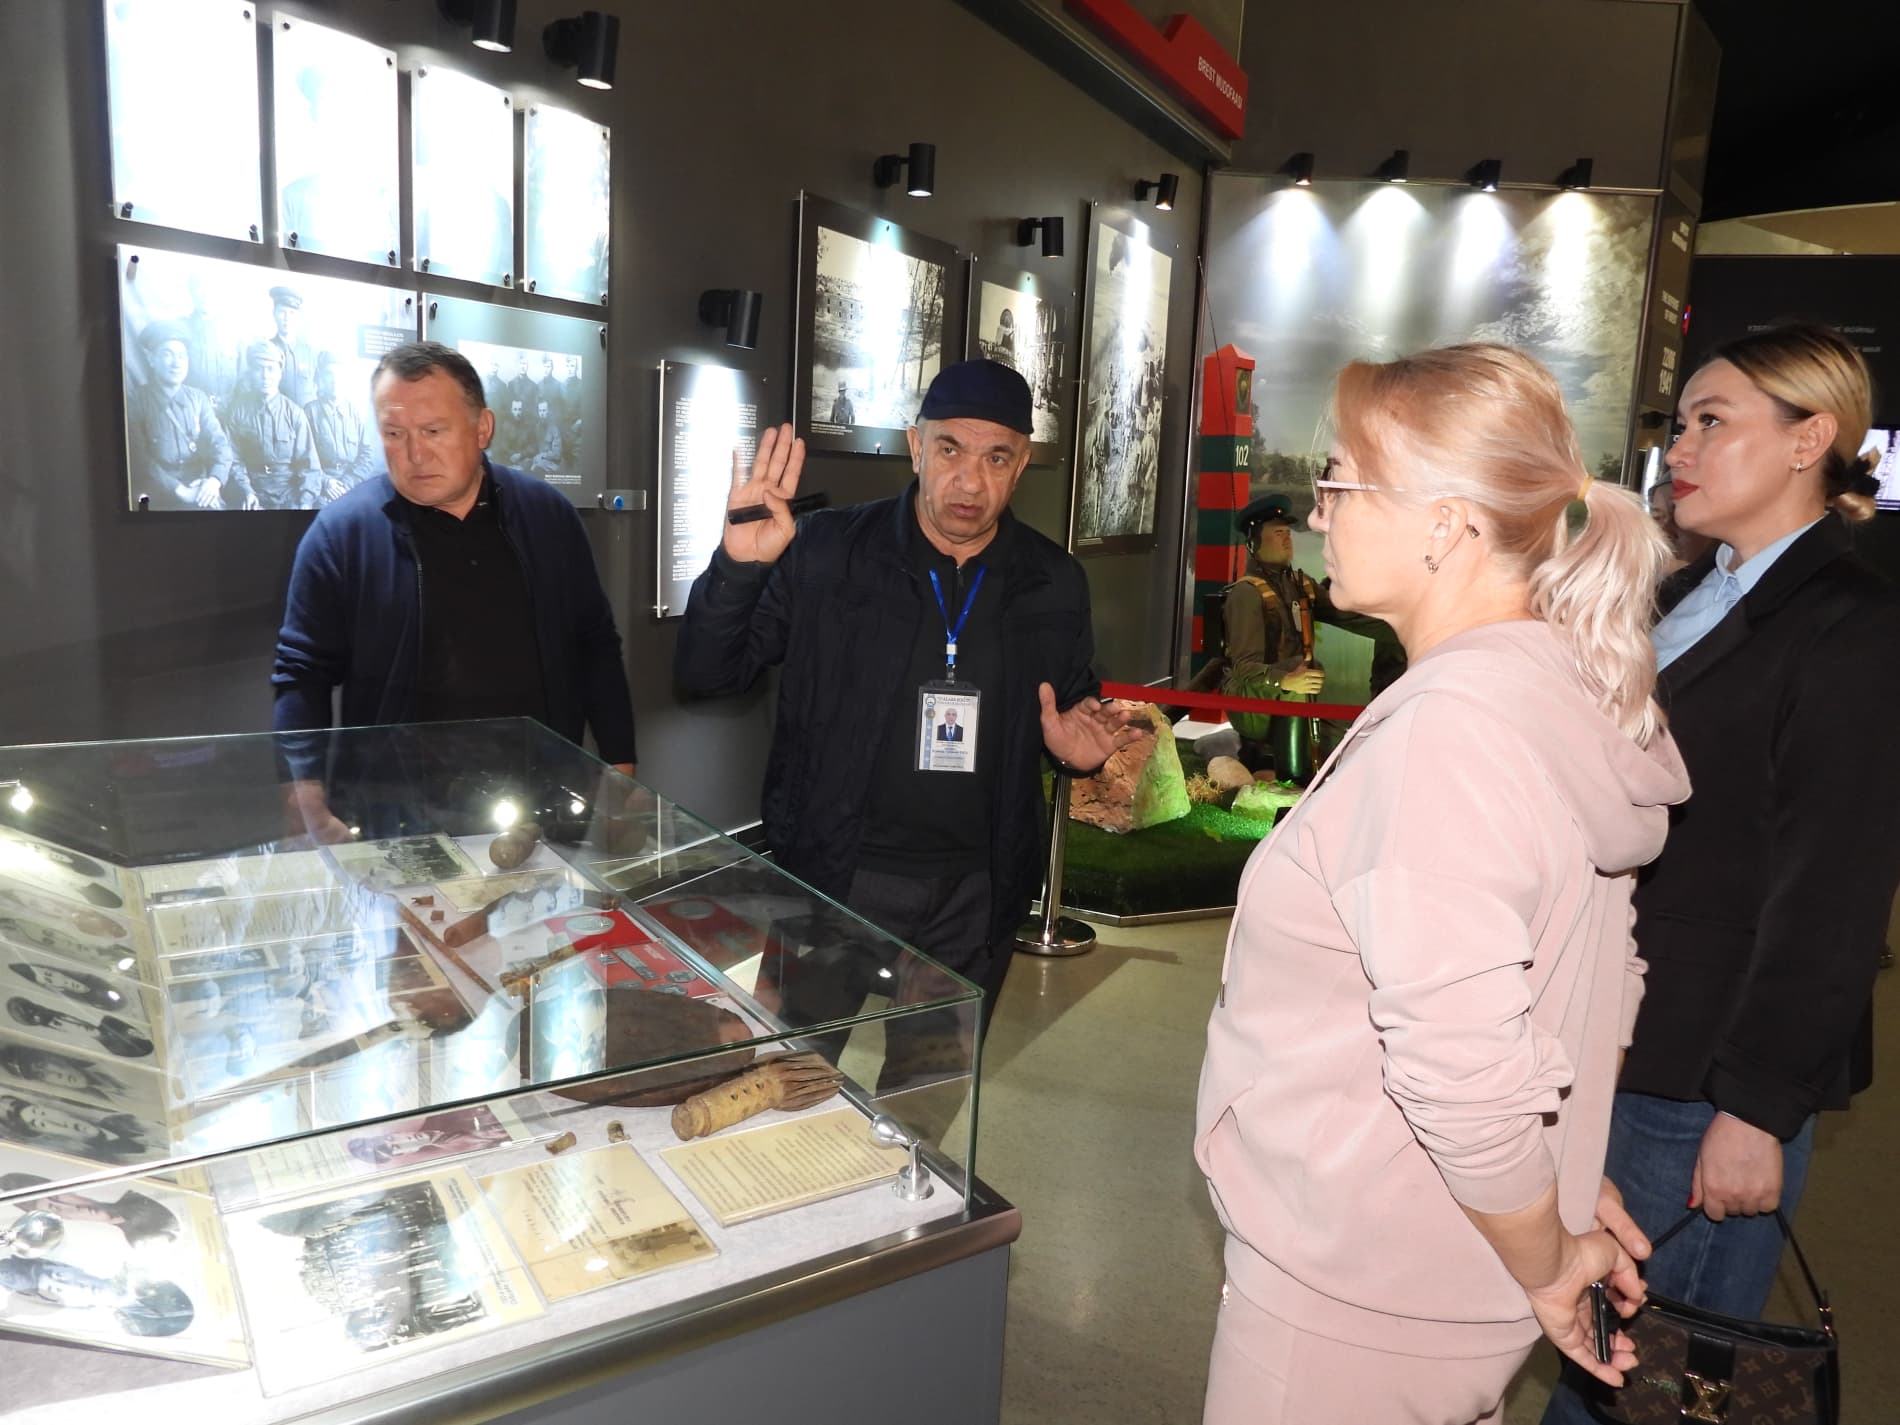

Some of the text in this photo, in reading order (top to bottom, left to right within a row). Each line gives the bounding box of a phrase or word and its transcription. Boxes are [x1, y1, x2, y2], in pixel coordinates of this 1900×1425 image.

[1198, 56, 1216, 83] BREST
[1659, 368, 1673, 396] 1941
[1235, 444, 1249, 467] 102
